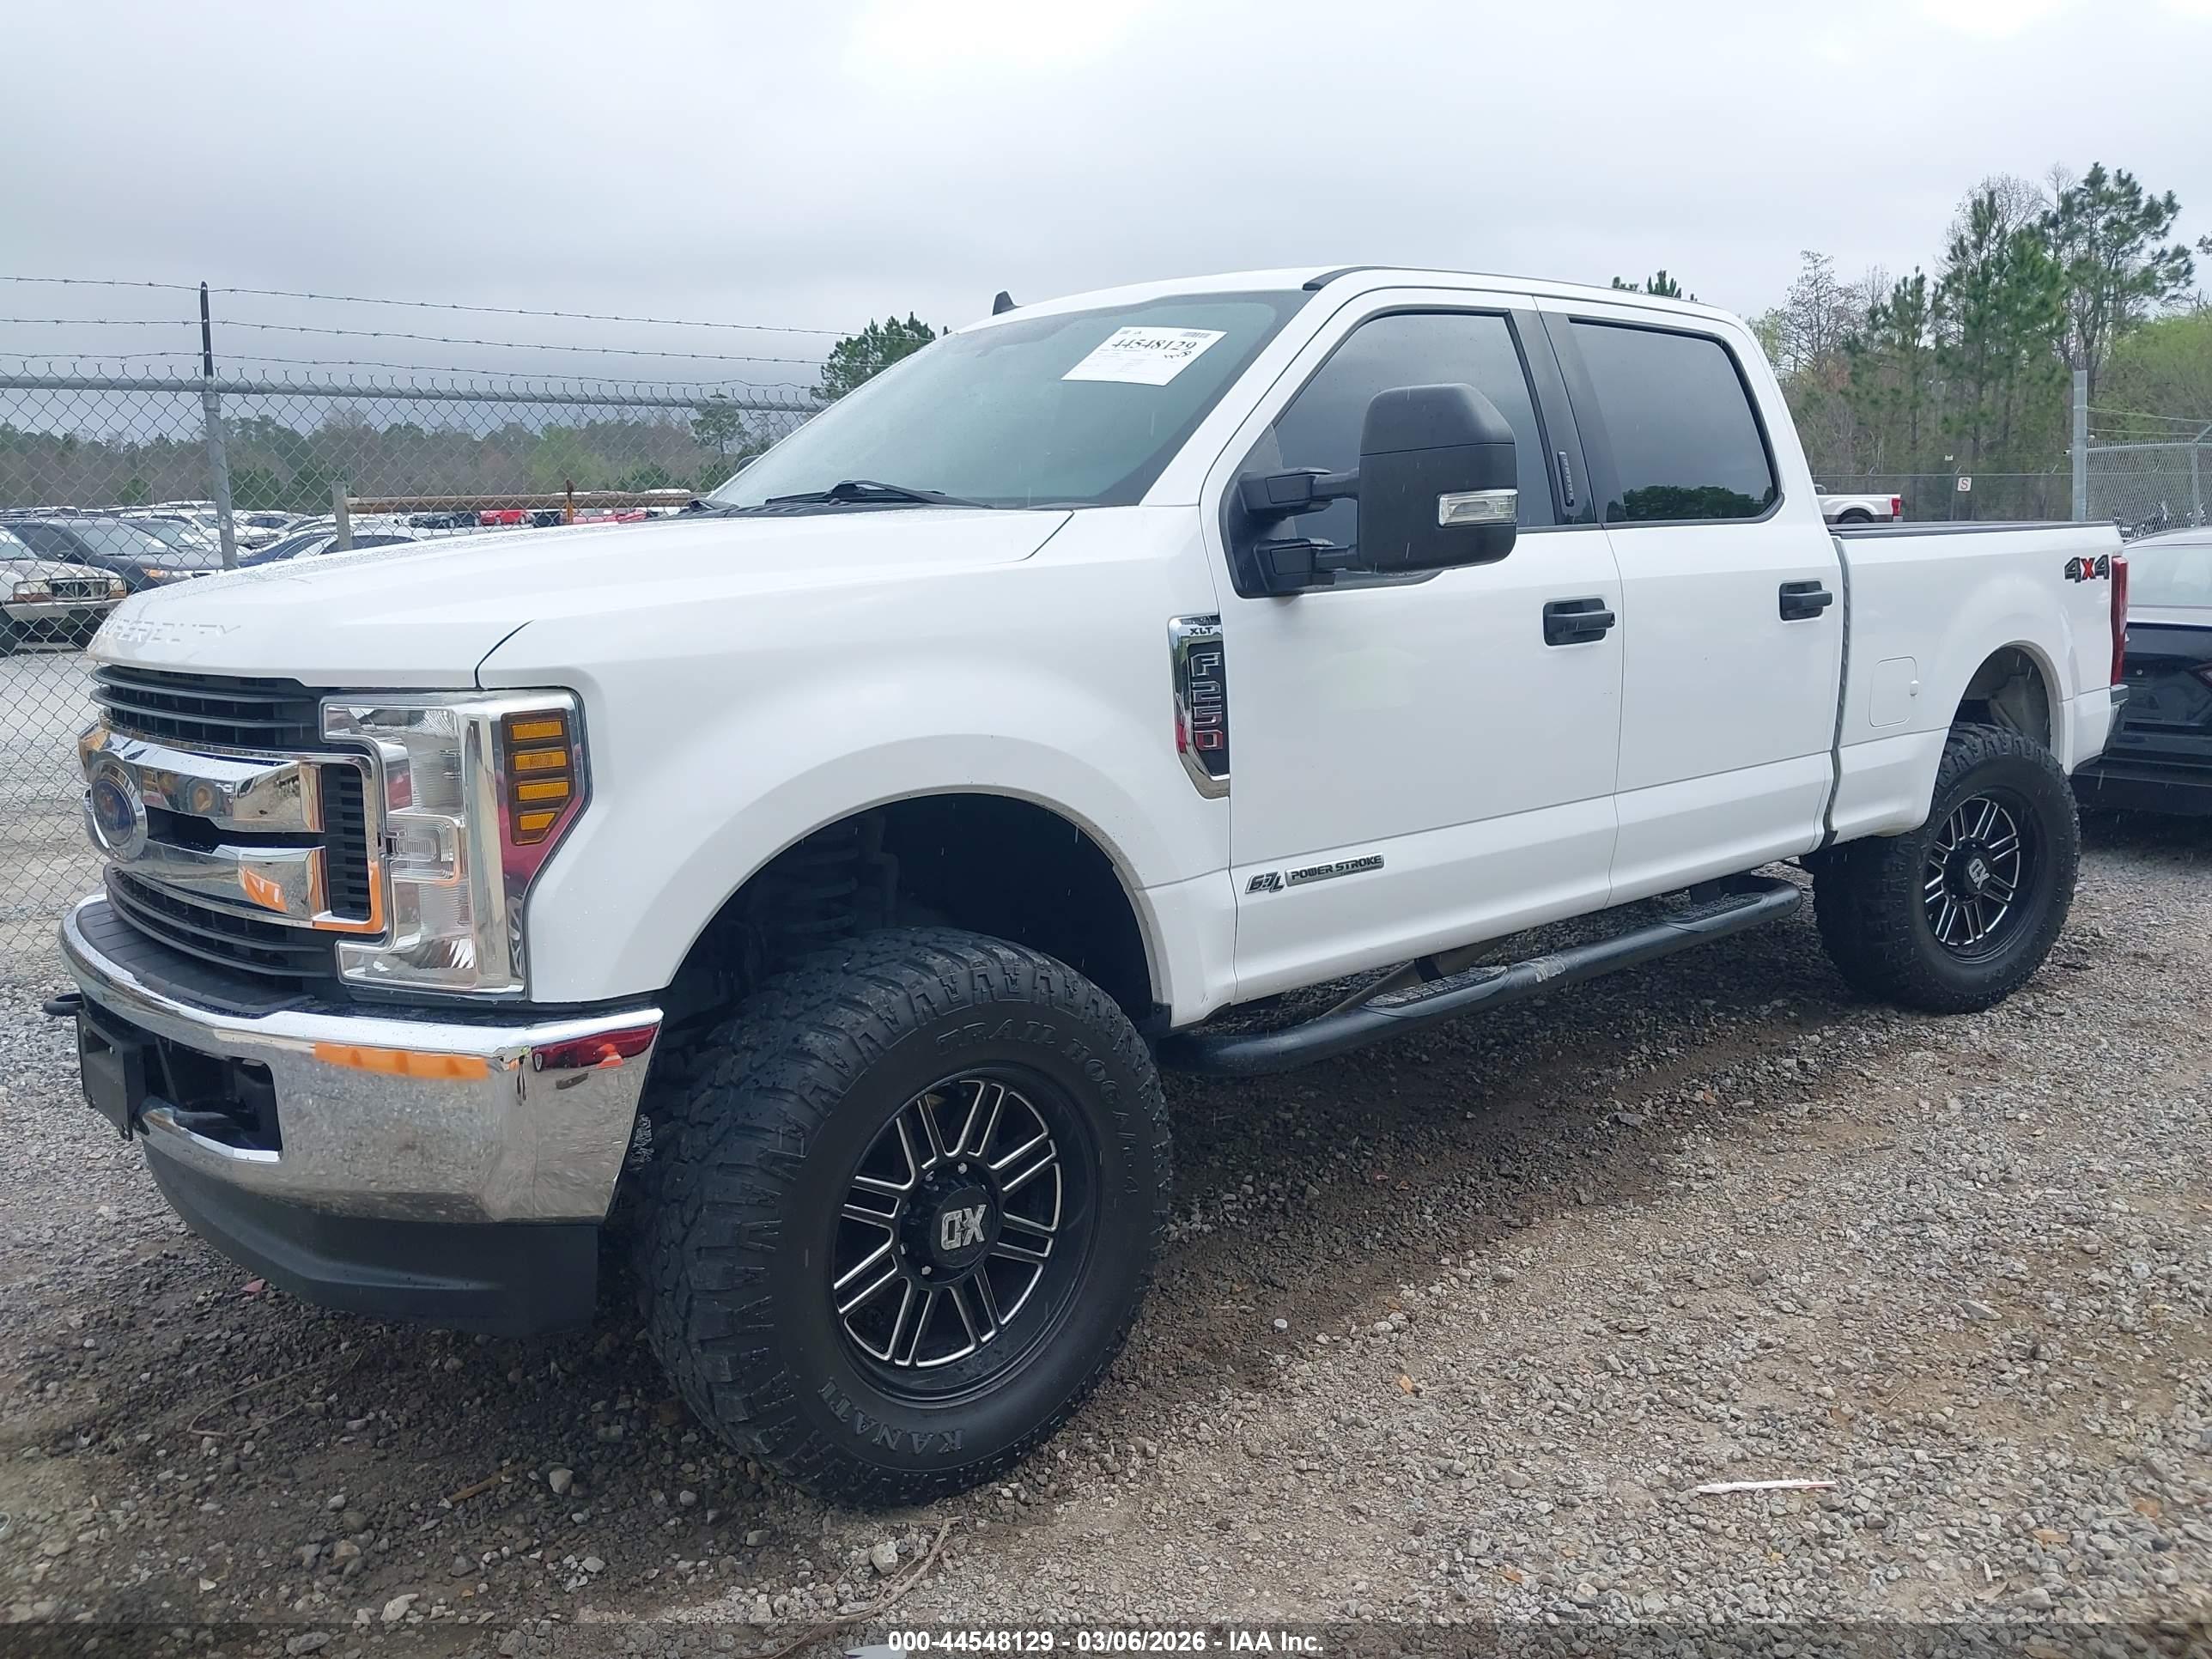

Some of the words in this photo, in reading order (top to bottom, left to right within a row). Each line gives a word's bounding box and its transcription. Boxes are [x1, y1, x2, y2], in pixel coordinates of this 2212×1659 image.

[1111, 338, 1197, 351] 44548129
[1960, 477, 1969, 490] S
[1189, 626, 1213, 636] XLT
[1291, 864, 1334, 882] POWER
[1335, 854, 1382, 872] STROKE
[817, 1376, 964, 1455] KANATI
